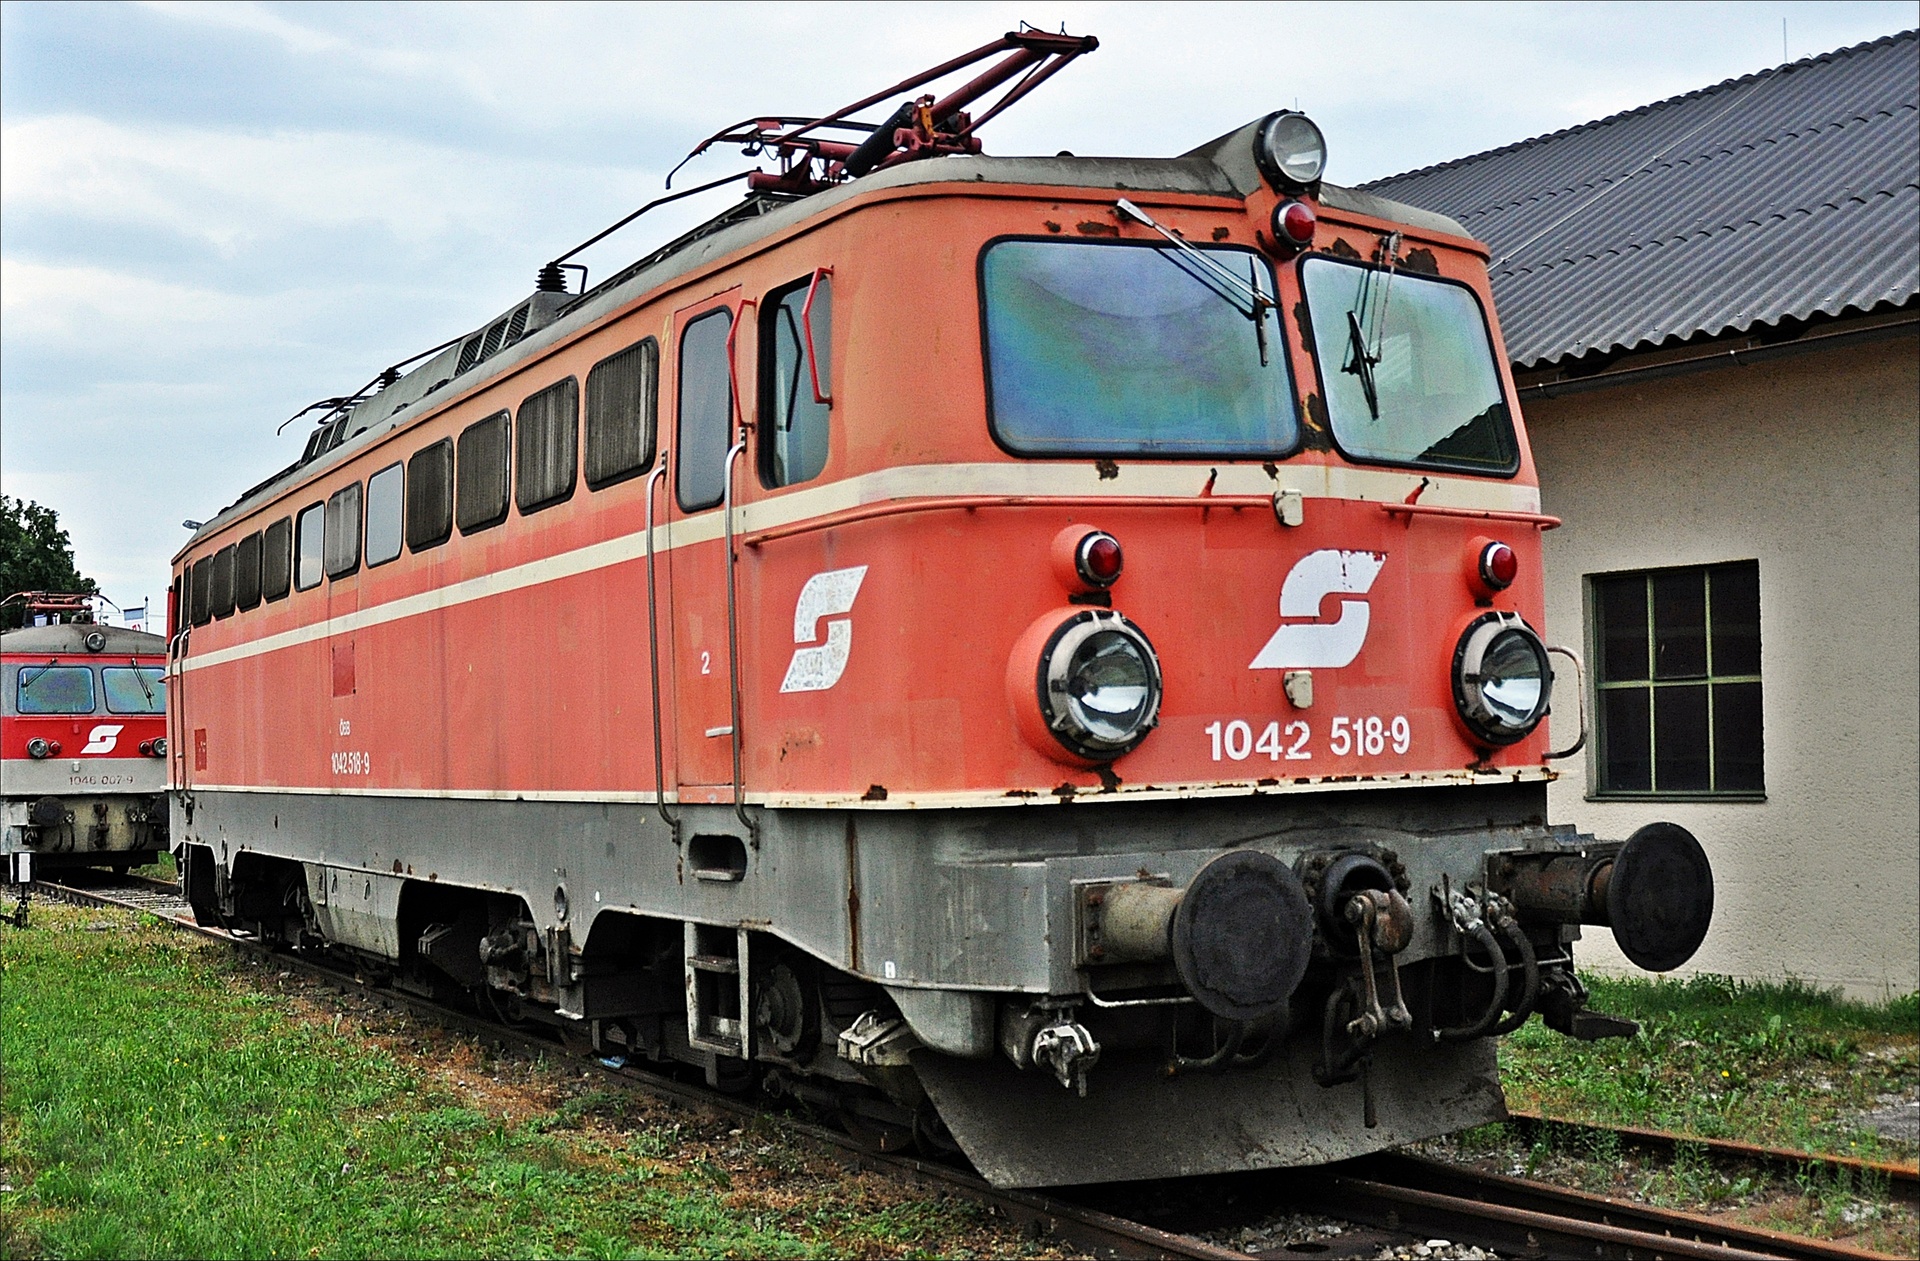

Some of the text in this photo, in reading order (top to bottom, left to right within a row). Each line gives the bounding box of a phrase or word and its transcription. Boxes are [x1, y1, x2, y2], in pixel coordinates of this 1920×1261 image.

[701, 651, 711, 675] 2
[340, 718, 351, 736] ÖBB
[1205, 716, 1411, 761] 1042 518-9
[331, 751, 370, 775] 1042 518-9
[69, 775, 97, 786] 1046
